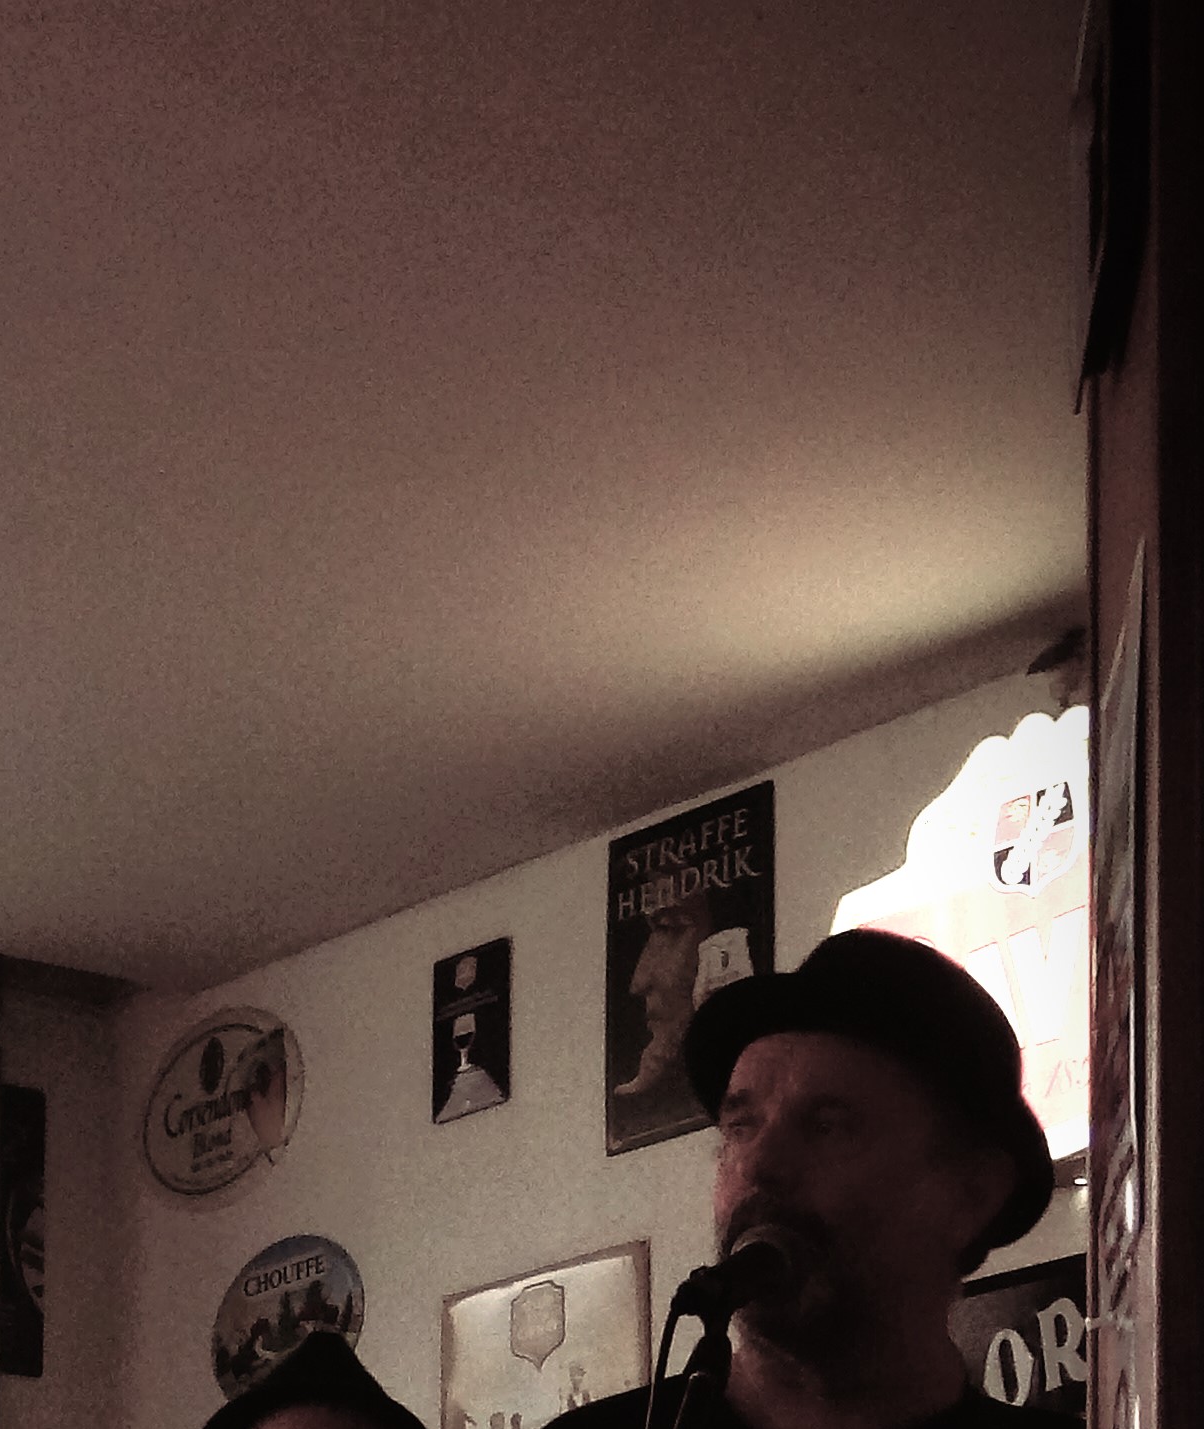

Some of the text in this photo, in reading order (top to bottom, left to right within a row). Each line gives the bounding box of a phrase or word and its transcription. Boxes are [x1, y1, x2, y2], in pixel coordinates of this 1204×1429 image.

[625, 808, 749, 880] STRAFFE
[617, 844, 763, 921] HENDRIK
[243, 1255, 324, 1297] CHOUFFE
[983, 1297, 1086, 1408] OR
